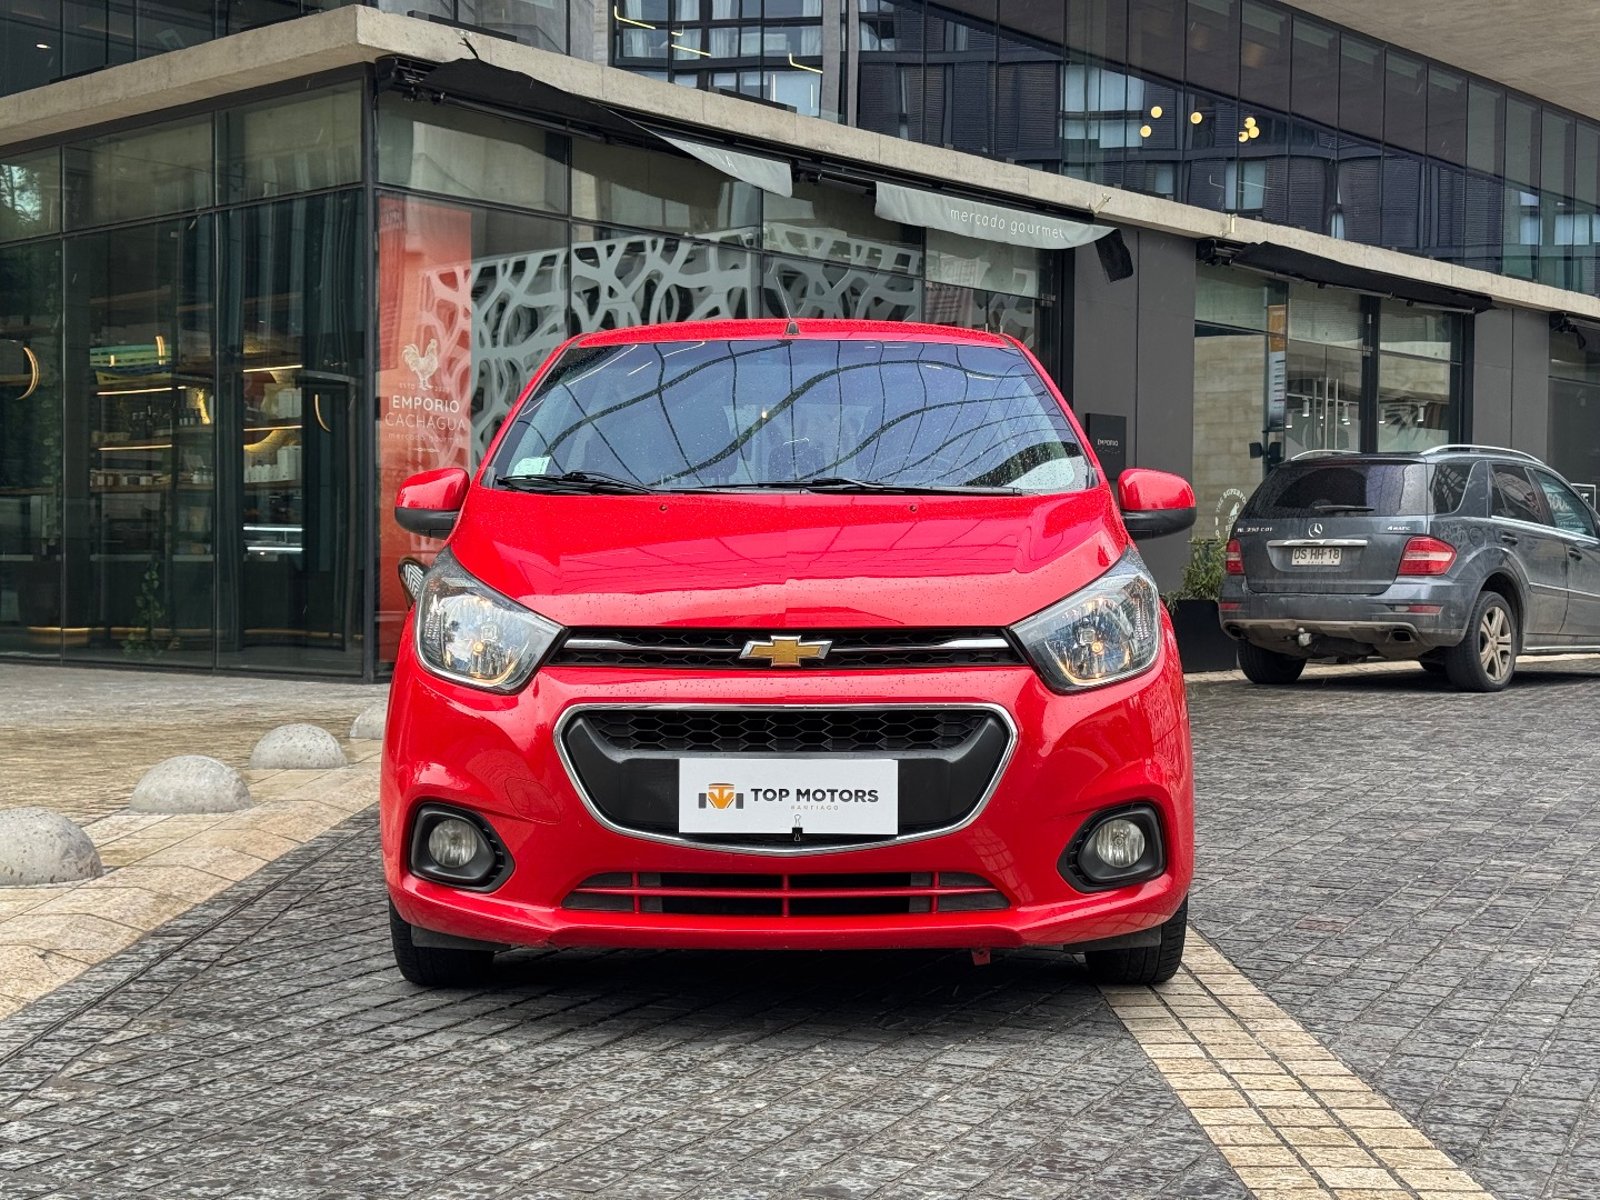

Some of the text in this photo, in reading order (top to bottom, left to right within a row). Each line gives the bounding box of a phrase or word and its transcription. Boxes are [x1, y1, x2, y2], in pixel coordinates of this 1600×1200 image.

[950, 209, 1065, 239] mercado gourmet
[392, 394, 460, 413] EMPORIO
[385, 411, 466, 431] CACHAGUA
[750, 788, 879, 803] TOP MOTORS
